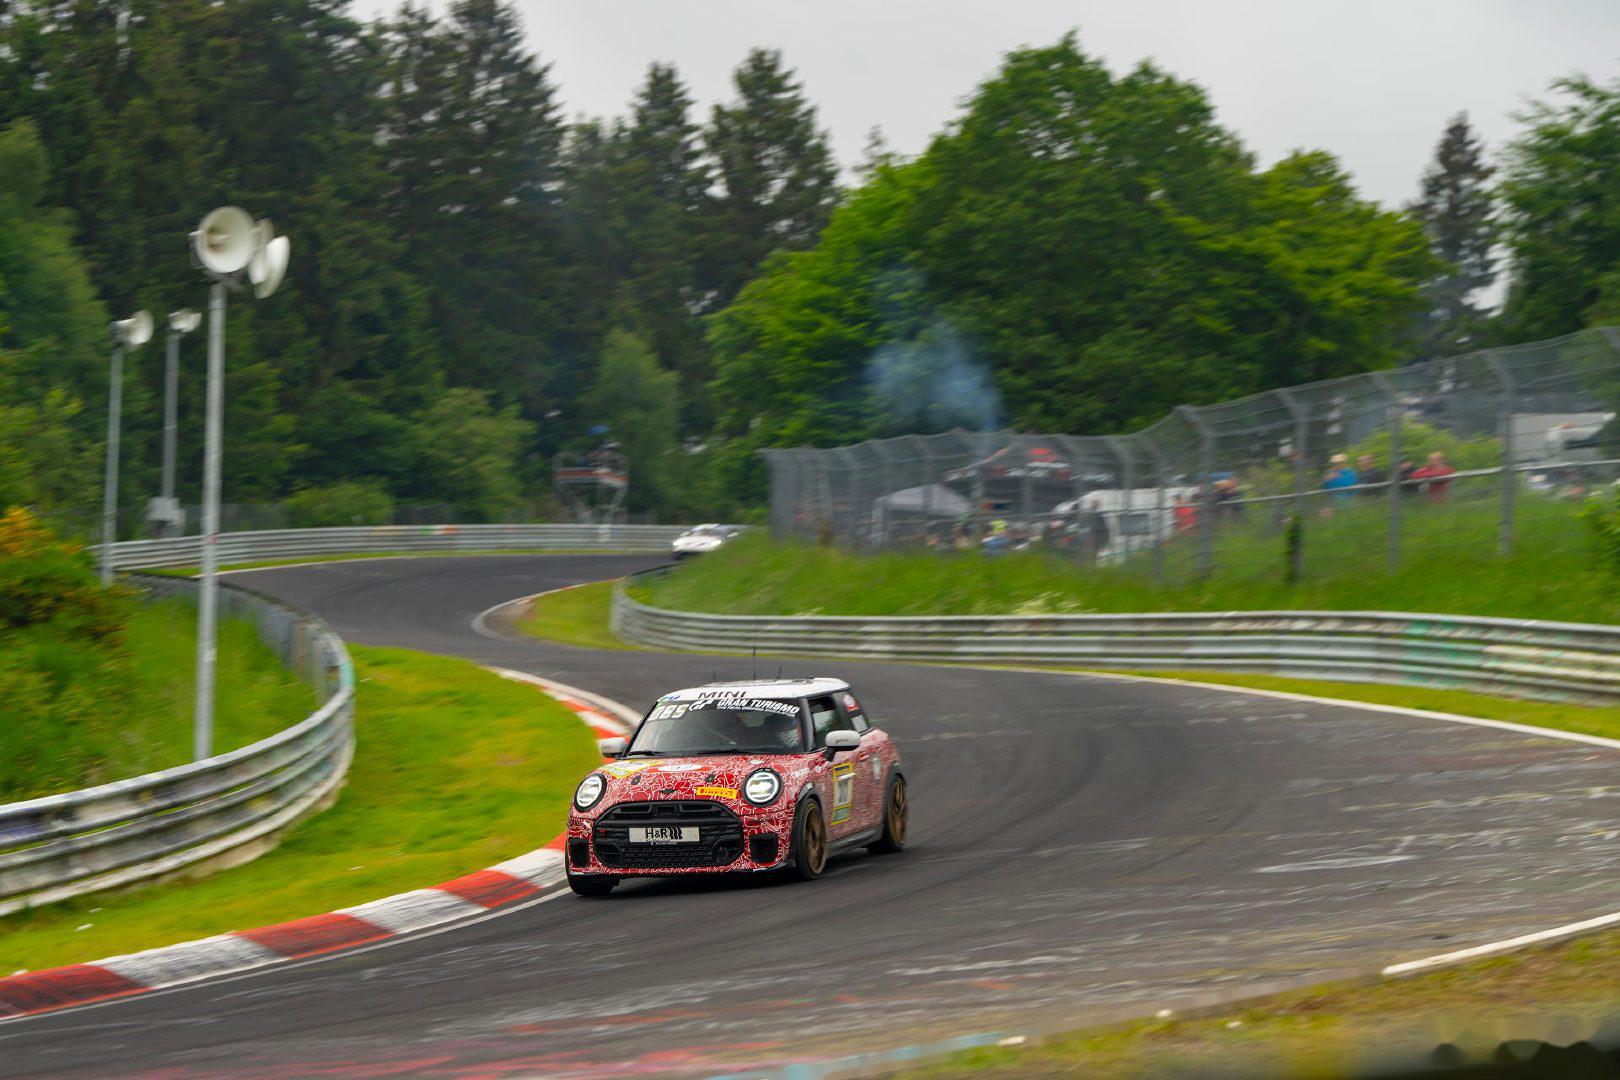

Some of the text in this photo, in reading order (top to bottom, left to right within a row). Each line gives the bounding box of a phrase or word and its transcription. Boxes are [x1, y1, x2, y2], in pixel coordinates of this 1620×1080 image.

[698, 691, 746, 699] MINI
[717, 698, 800, 714] GRAN TURISMO
[645, 828, 668, 839] H&R
